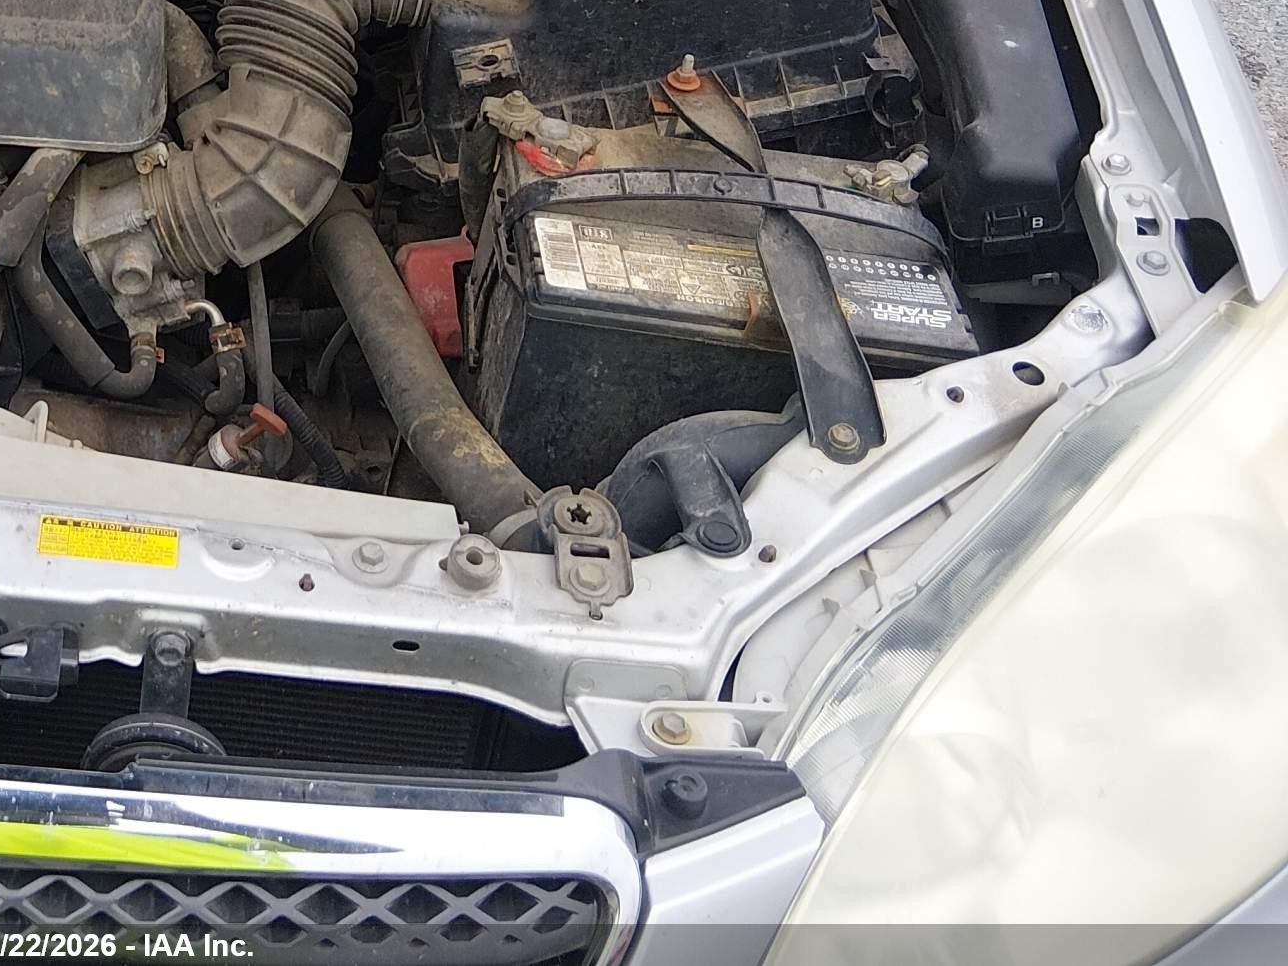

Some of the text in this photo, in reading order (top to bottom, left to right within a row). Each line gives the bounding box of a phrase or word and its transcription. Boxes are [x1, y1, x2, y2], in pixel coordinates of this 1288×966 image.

[871, 301, 952, 323] START
[873, 310, 947, 329] SUPER
[80, 521, 122, 531] CAUTION
[129, 526, 177, 537] ATTENTION
